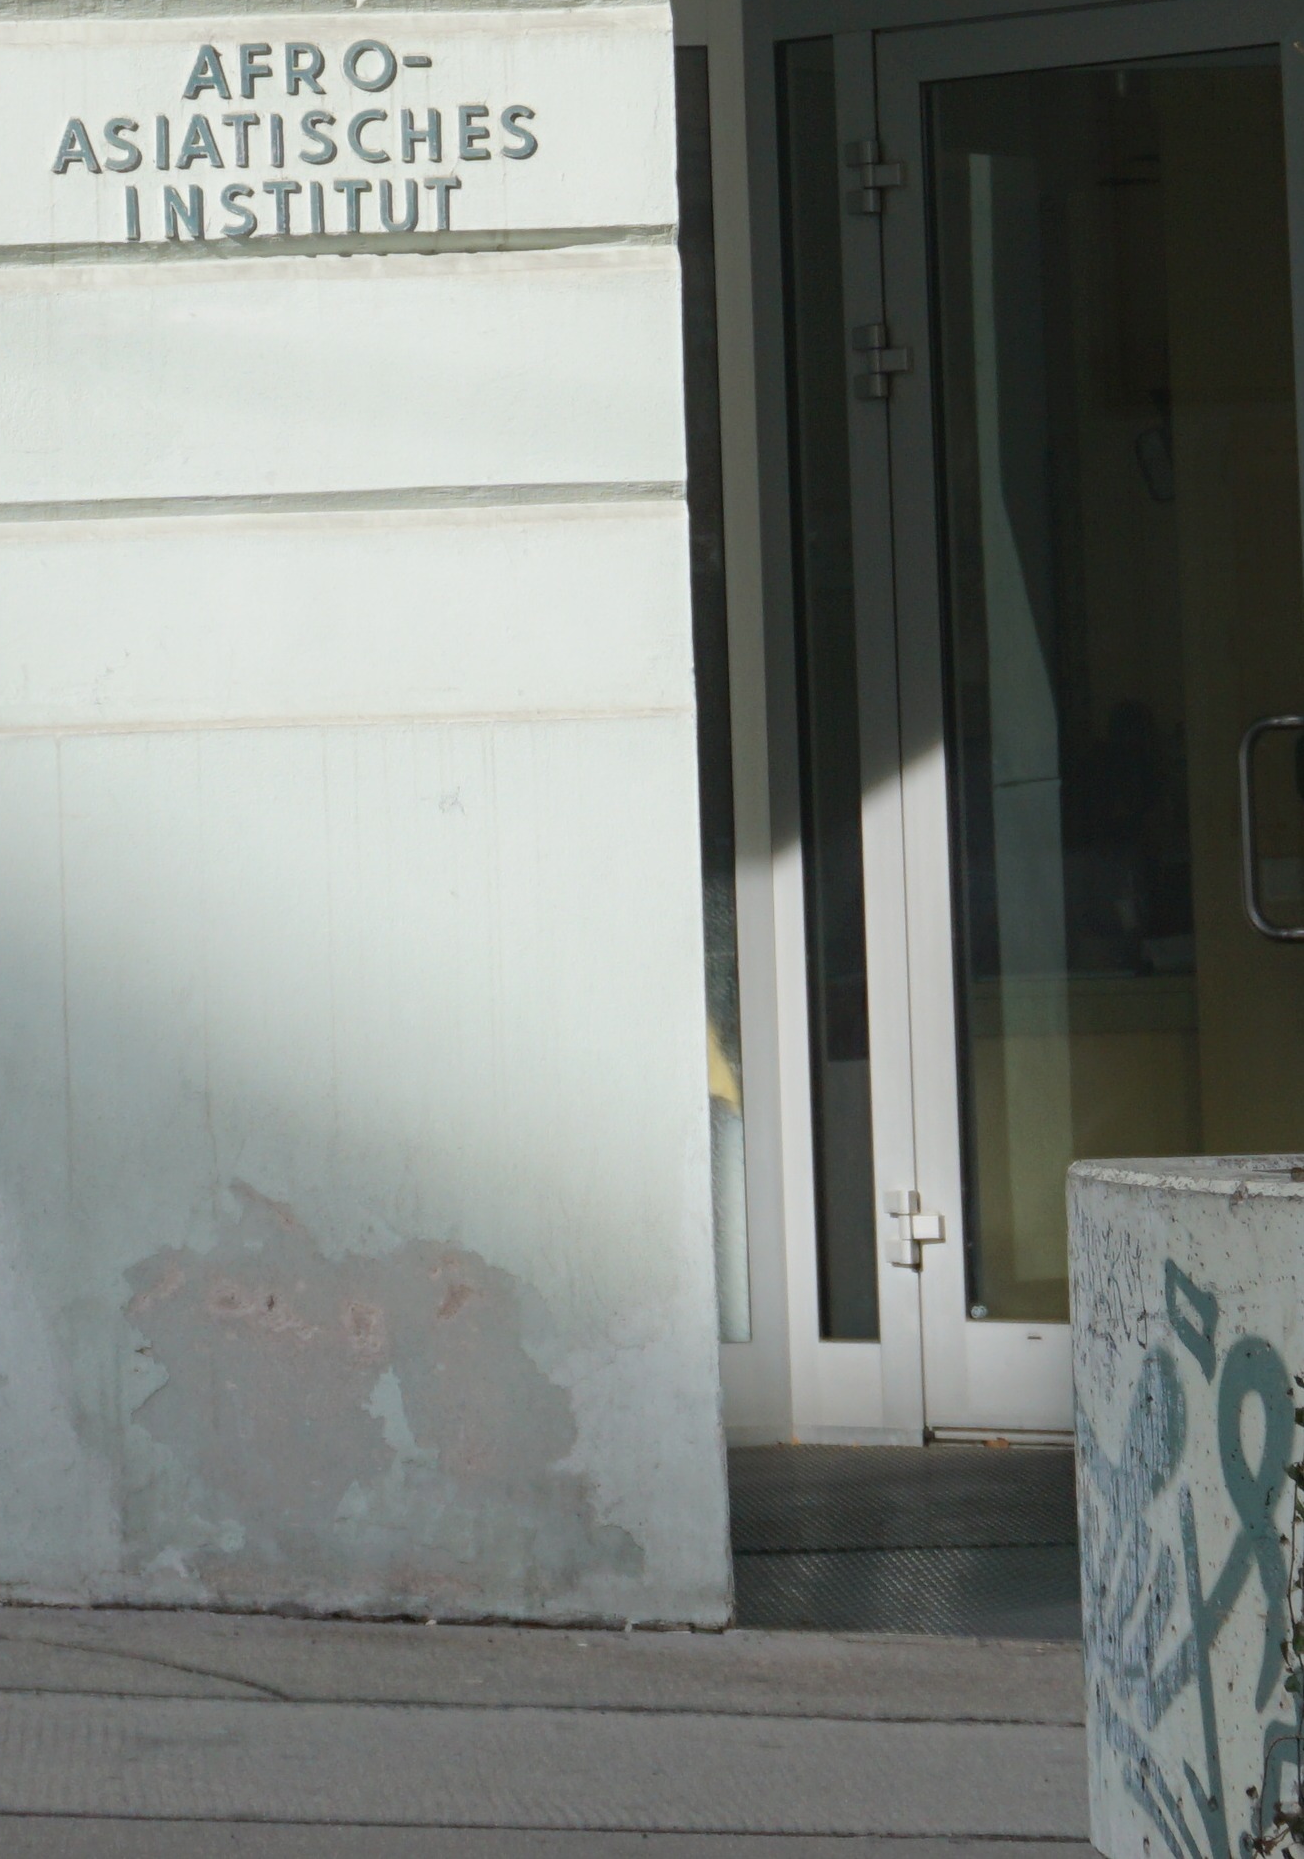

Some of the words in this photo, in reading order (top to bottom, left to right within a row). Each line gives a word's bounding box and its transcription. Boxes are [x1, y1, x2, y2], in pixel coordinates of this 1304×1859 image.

[182, 38, 433, 100] AFRO-
[51, 104, 539, 175] ASIATISCHES
[124, 175, 462, 242] INSTITUT
